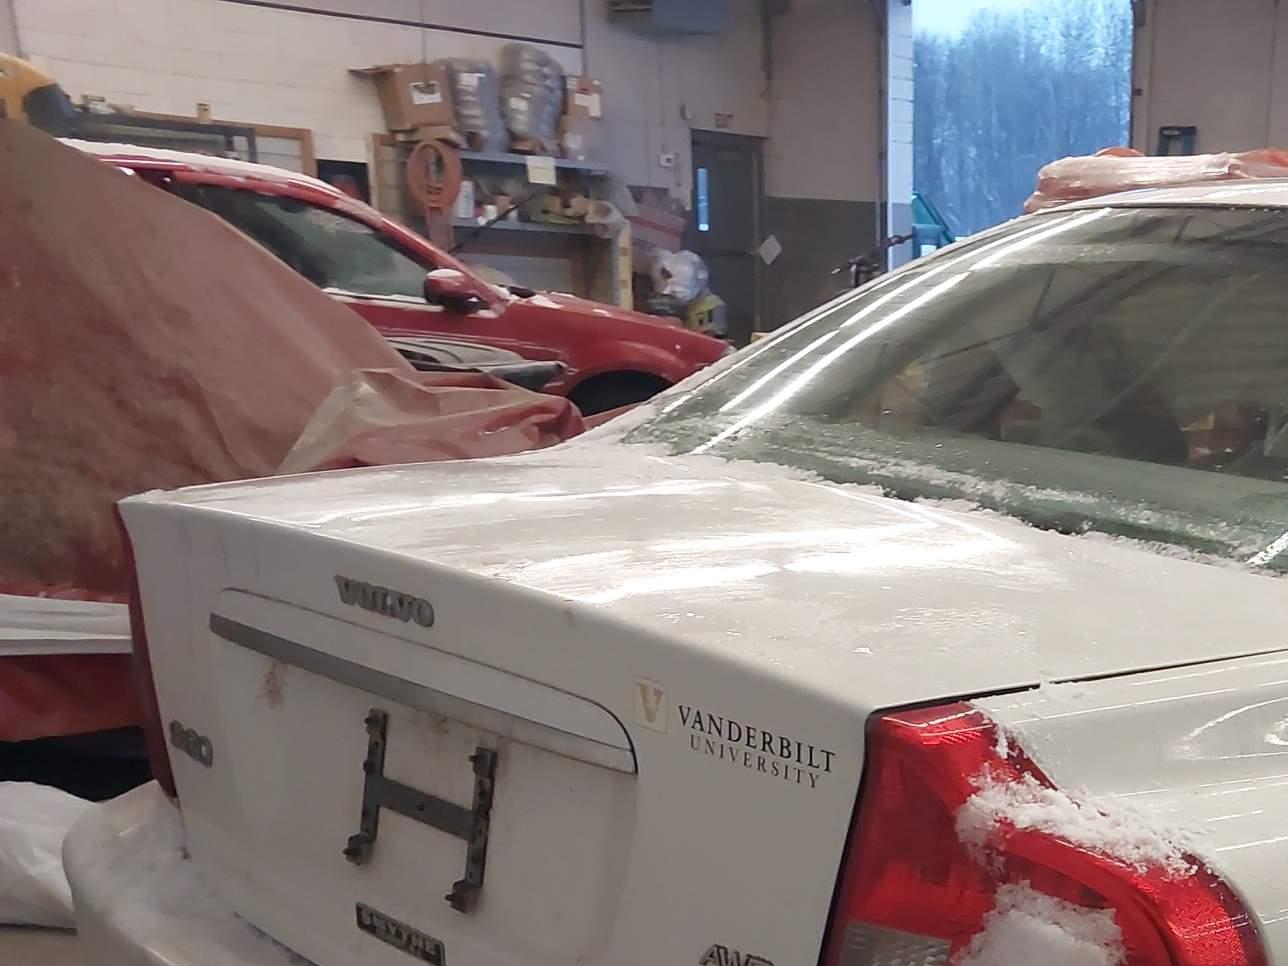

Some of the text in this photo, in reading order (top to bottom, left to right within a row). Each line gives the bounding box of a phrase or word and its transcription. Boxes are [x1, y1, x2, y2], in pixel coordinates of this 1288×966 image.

[334, 574, 435, 628] VOLVO
[677, 704, 837, 774] VANDERBILT
[689, 733, 821, 789] UNIVERSITY
